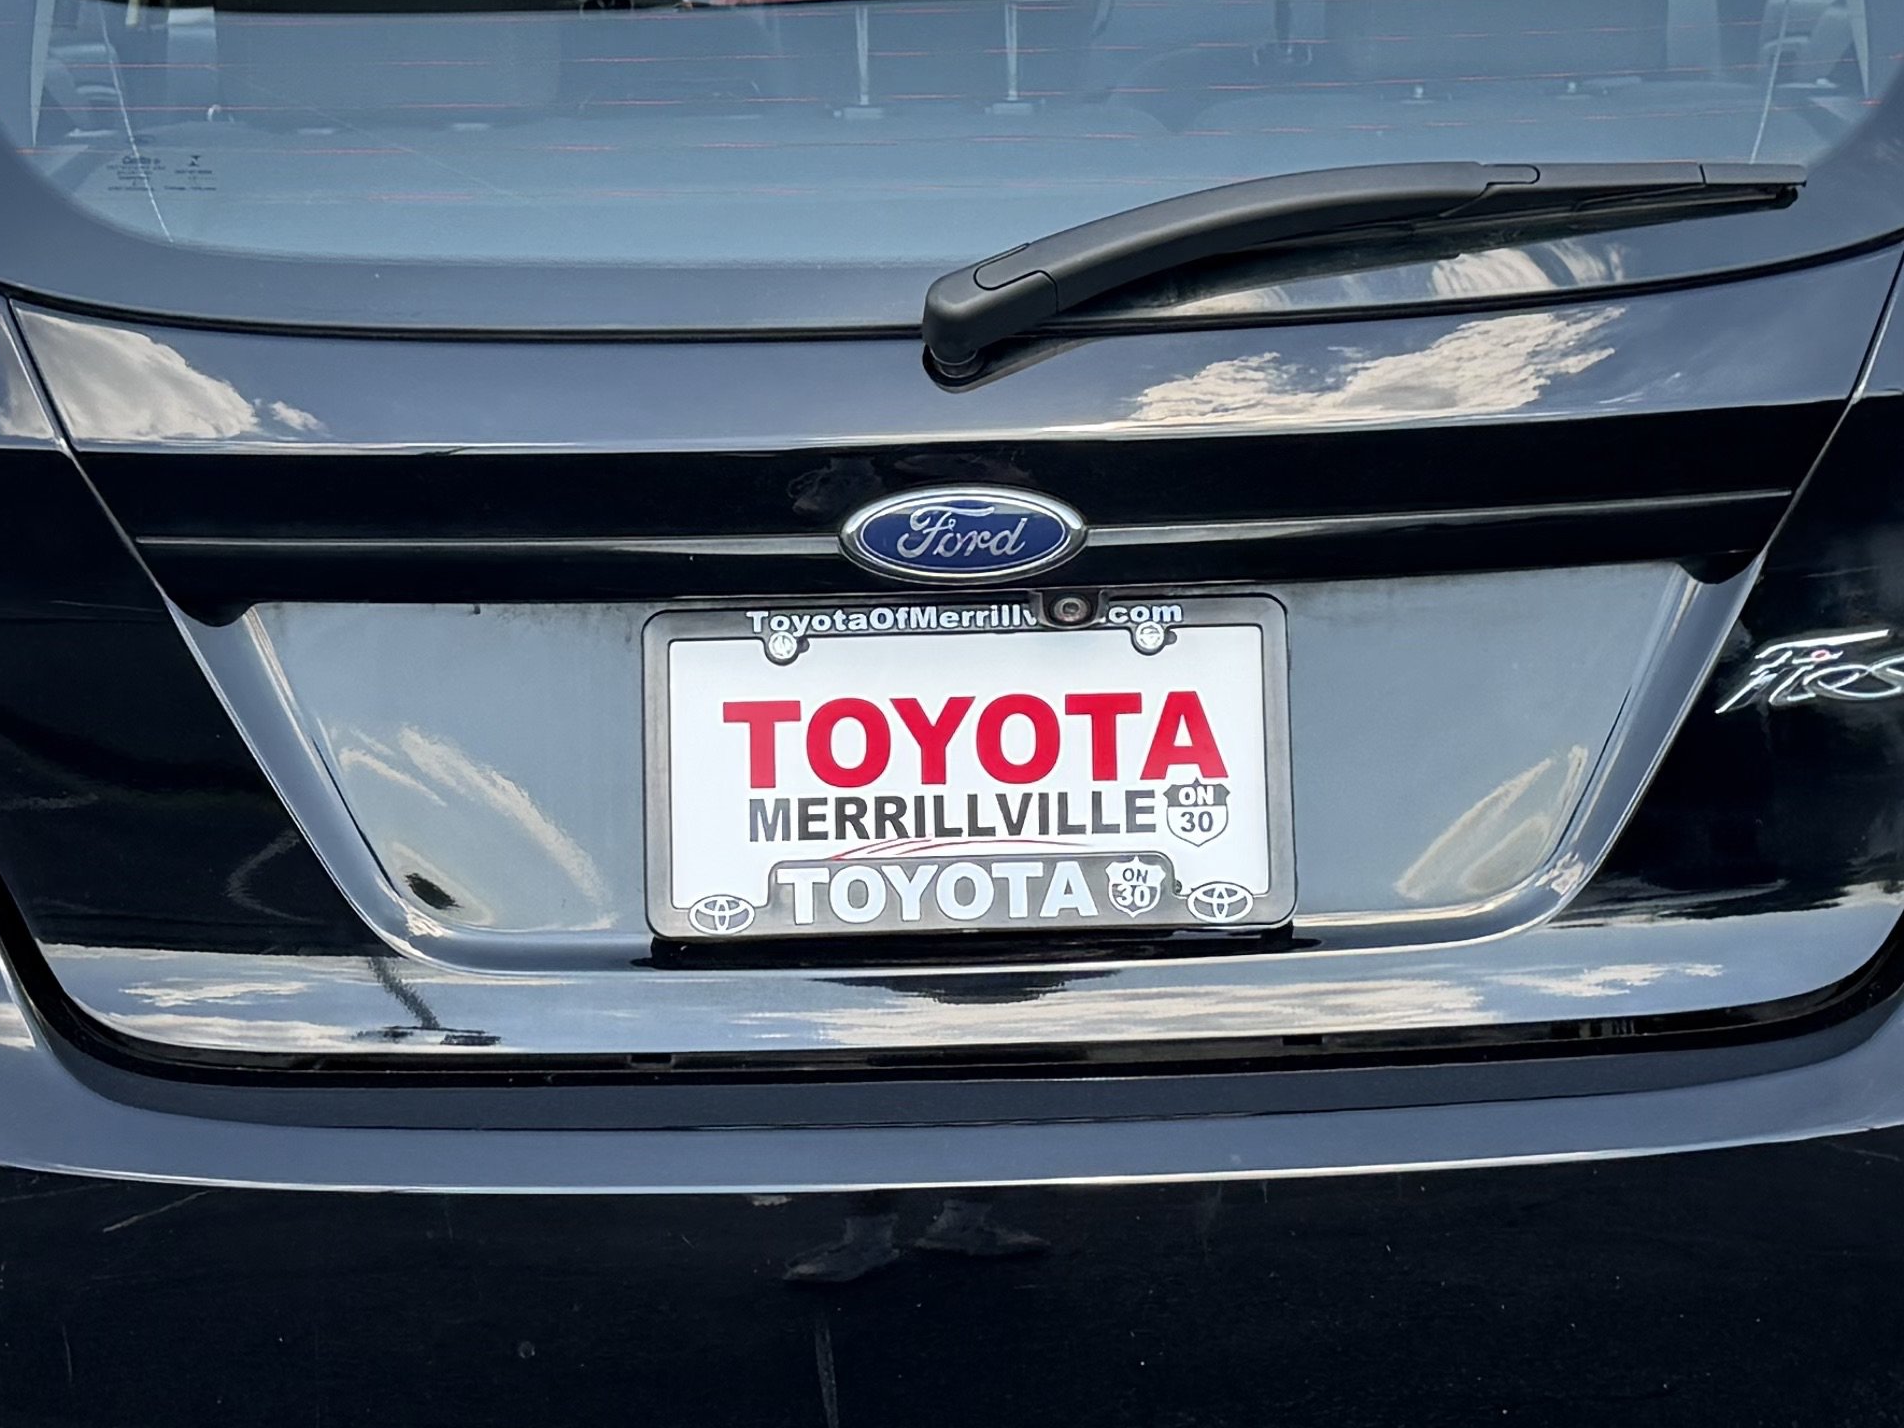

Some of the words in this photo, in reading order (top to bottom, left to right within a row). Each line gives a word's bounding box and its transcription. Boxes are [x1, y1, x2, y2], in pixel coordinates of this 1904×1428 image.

[896, 505, 1029, 559] Ford
[722, 690, 1229, 789] TOYOTA
[1177, 785, 1215, 806] ON
[748, 789, 1158, 843] MERRILLVILLE
[1179, 810, 1215, 833] 30
[776, 860, 1099, 925] TOYOTA
[1121, 867, 1149, 884] ON
[1114, 883, 1152, 908] 30
